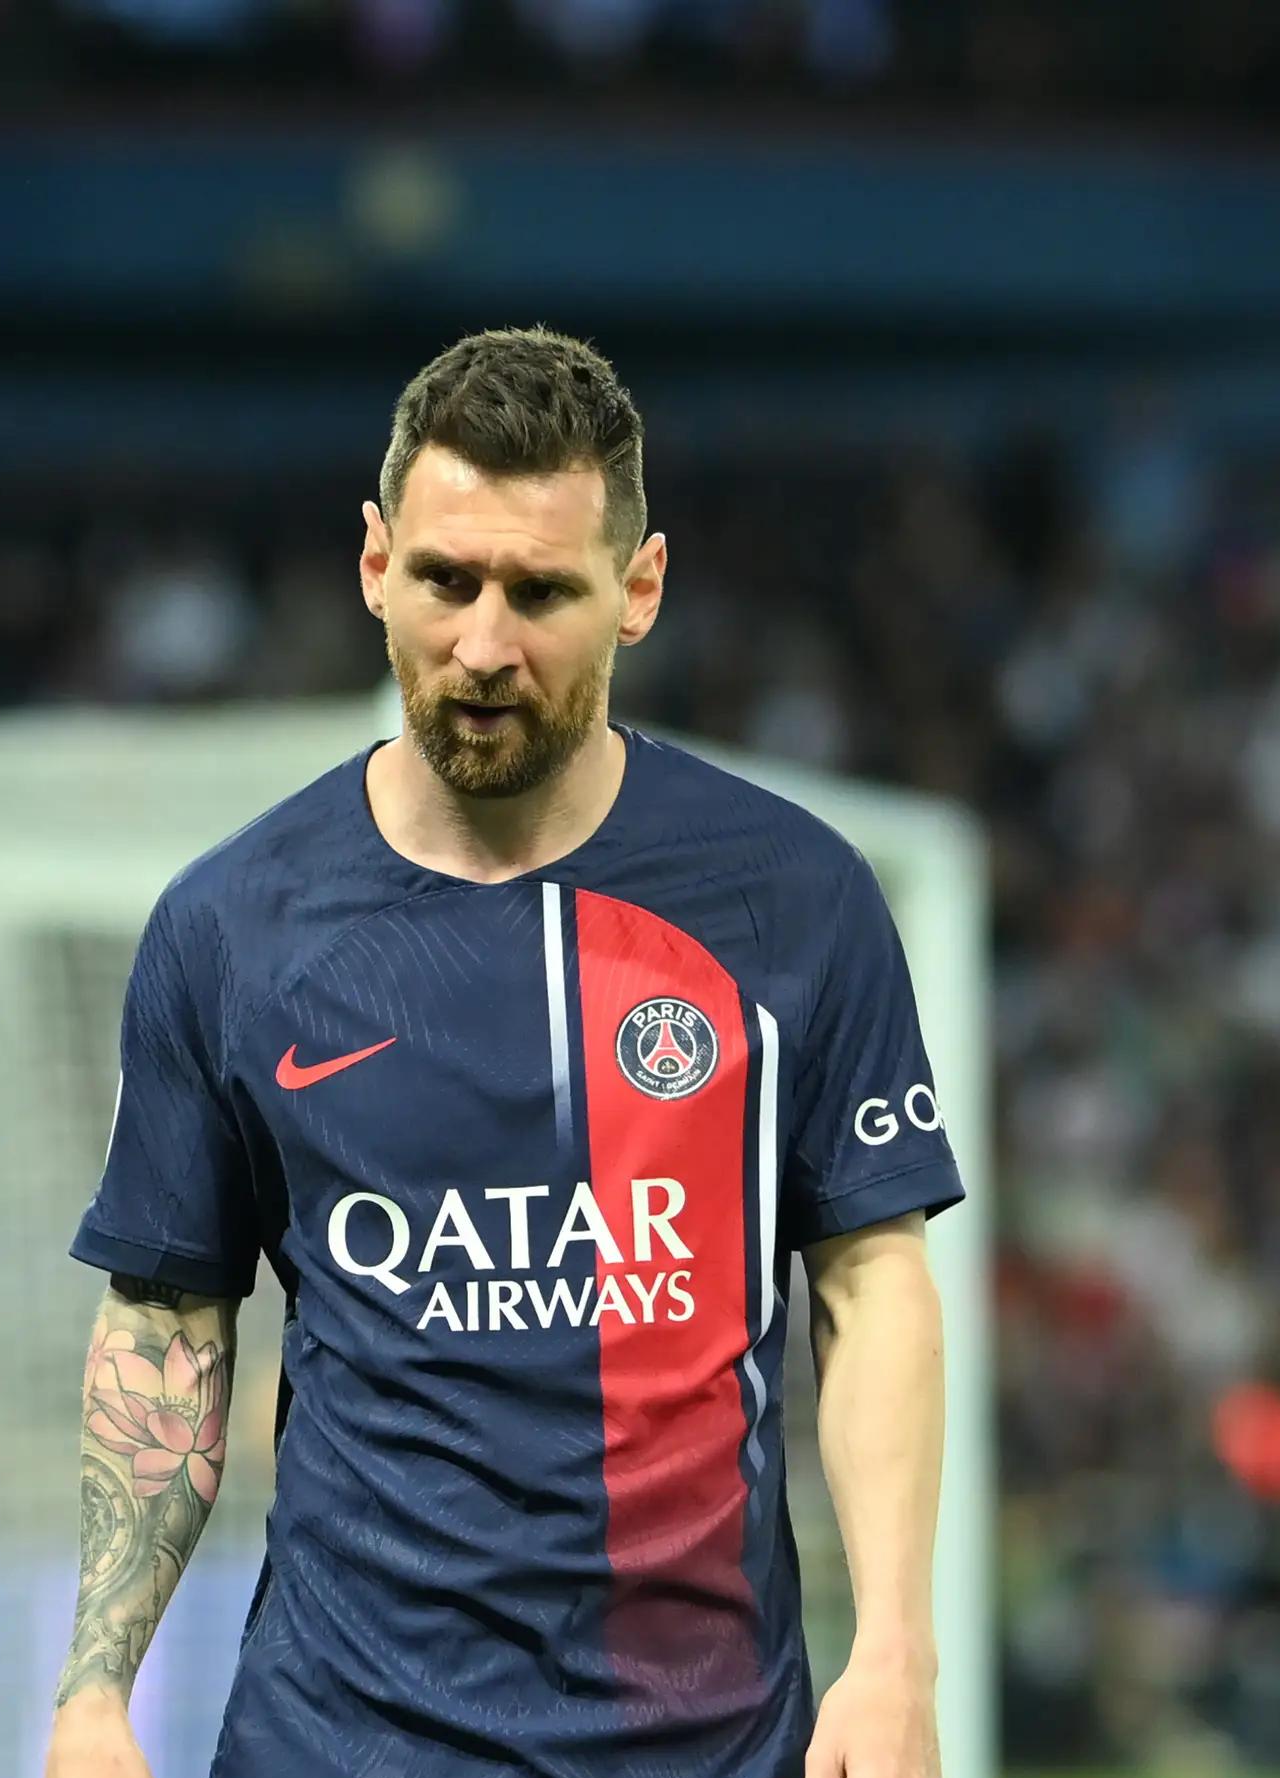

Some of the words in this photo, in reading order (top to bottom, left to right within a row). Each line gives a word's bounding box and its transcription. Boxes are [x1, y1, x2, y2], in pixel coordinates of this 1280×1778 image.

[632, 1003, 697, 1029] PARIS
[854, 1083, 945, 1146] GO
[327, 1177, 695, 1295] QATAR
[416, 1270, 695, 1332] AIRWAYS
